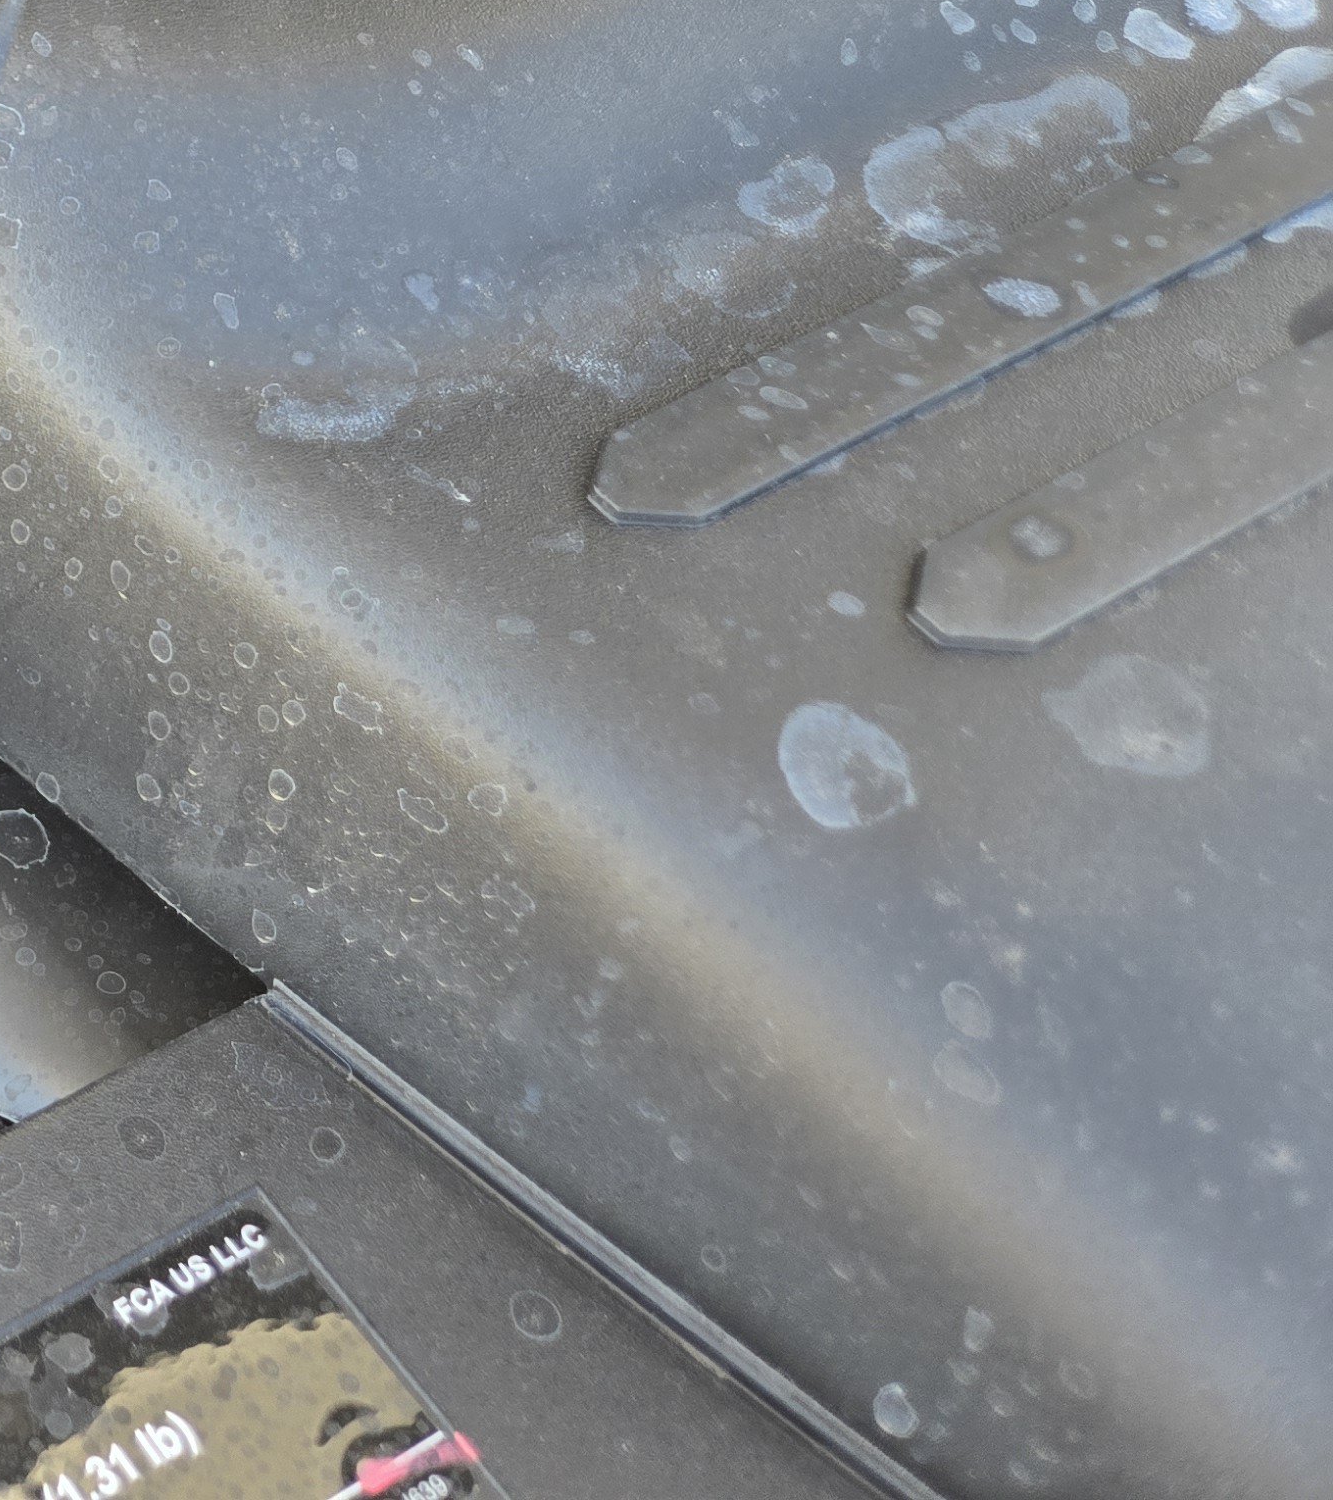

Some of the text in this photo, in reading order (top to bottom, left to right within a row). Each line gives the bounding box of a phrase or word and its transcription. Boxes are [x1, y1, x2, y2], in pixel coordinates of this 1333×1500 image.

[111, 1222, 269, 1326] FCA US LLC
[134, 1409, 200, 1466] lb)
